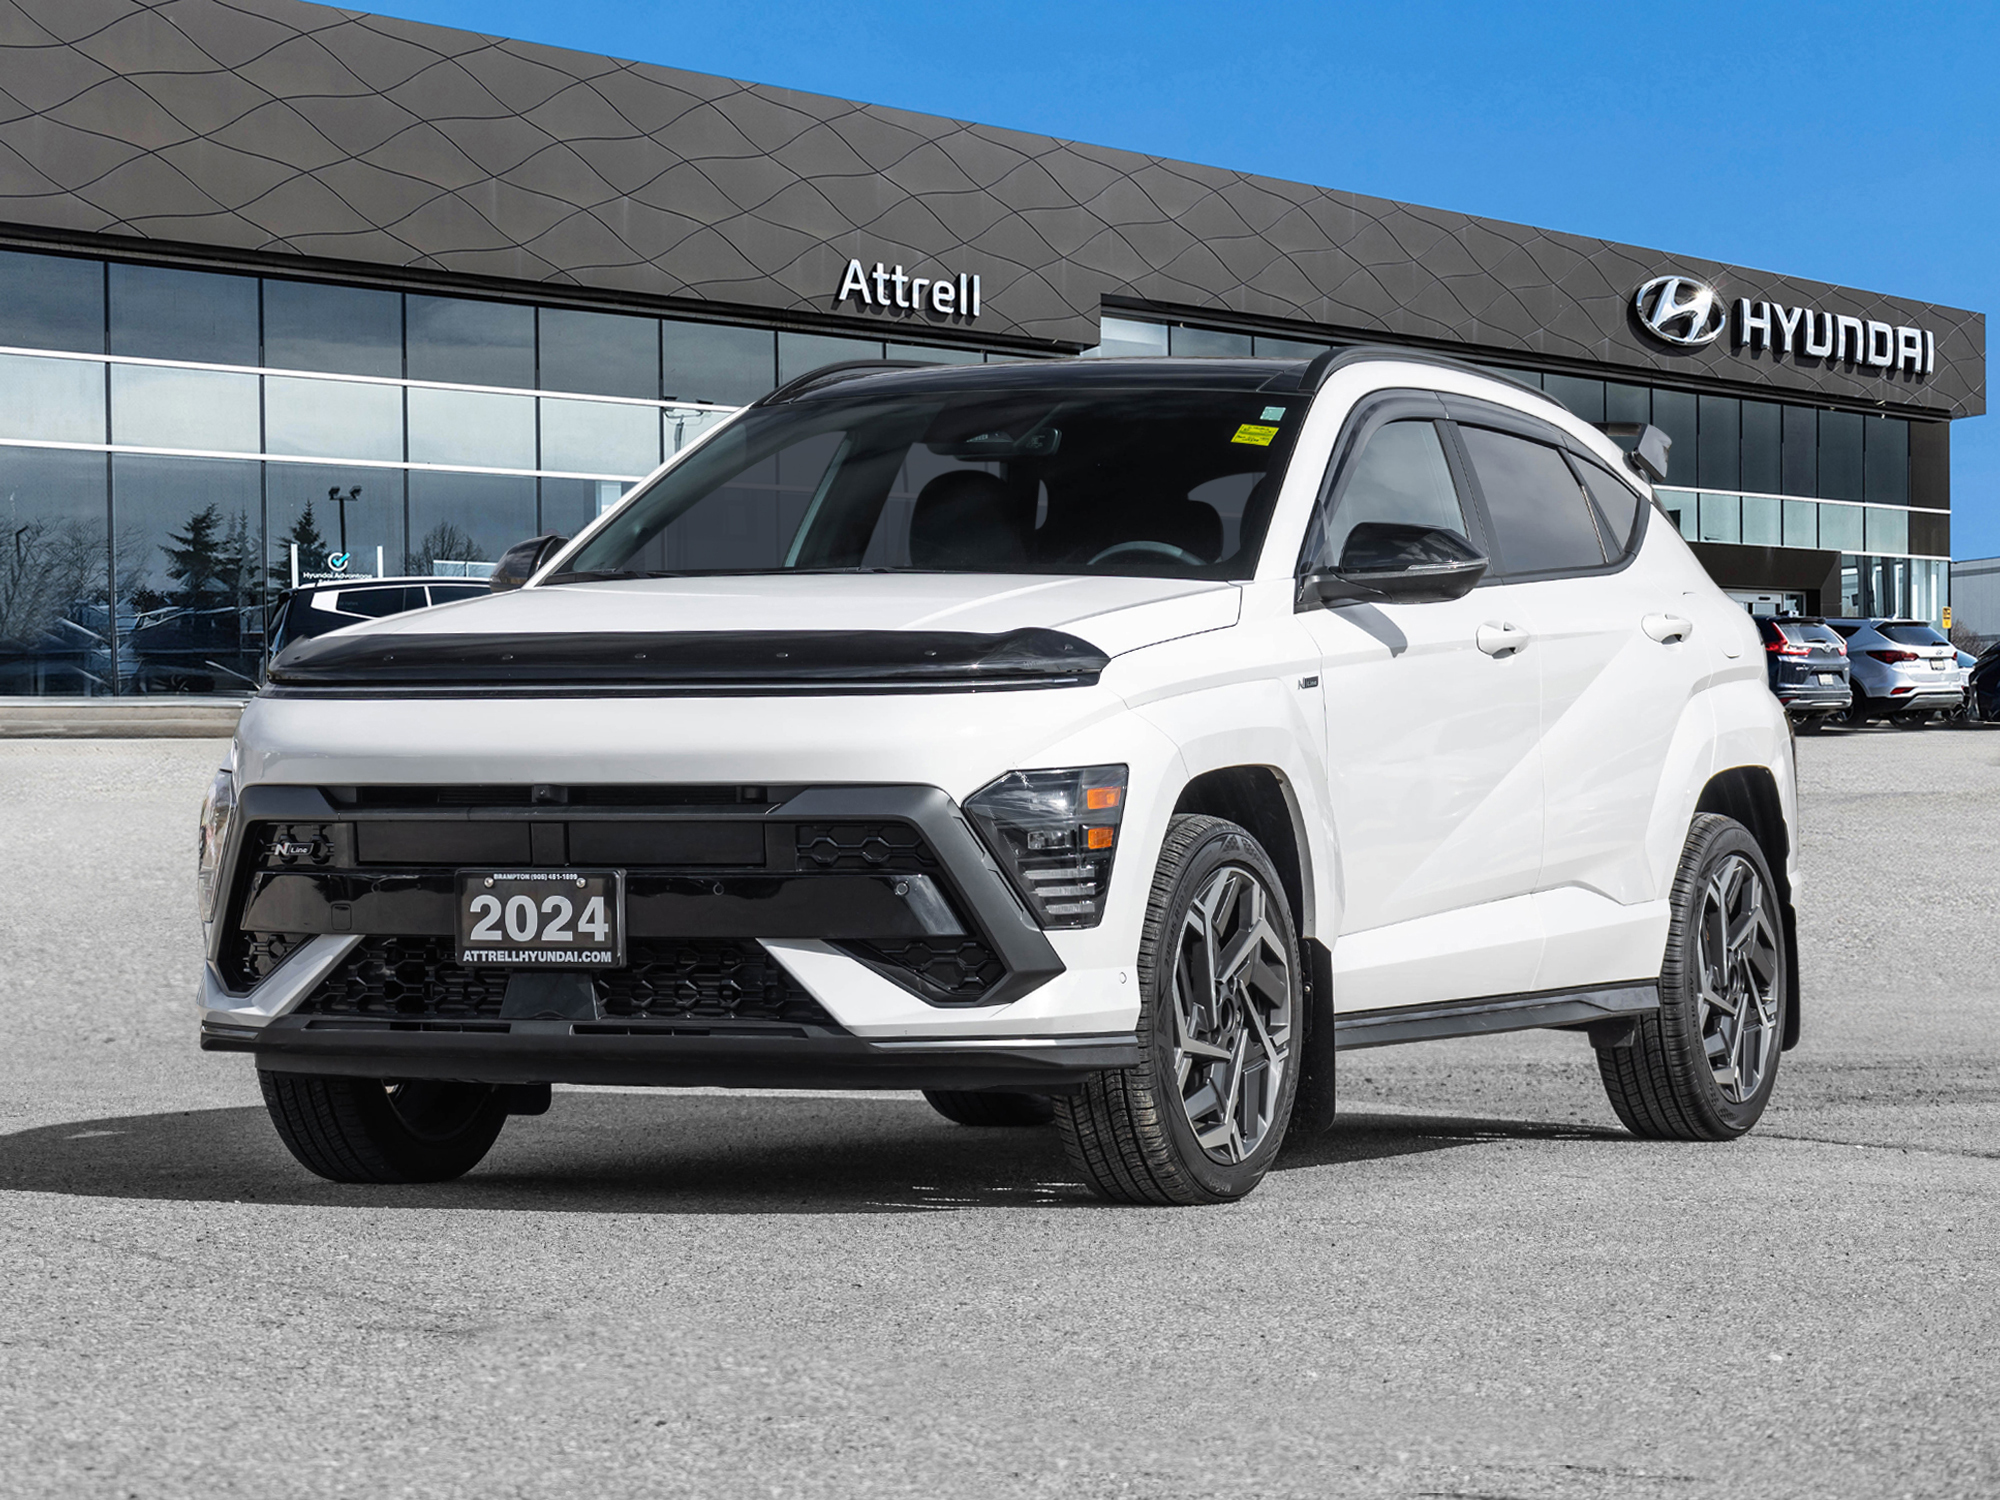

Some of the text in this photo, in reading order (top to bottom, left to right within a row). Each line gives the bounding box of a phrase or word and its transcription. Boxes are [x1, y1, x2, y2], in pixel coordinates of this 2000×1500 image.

[838, 258, 980, 317] Attrell
[1739, 297, 1936, 376] HYUNDAI
[274, 842, 290, 855] N
[530, 873, 547, 881] (905)
[469, 894, 609, 942] 2024
[462, 951, 612, 963] ATTRELLHYUNDAI.COM
